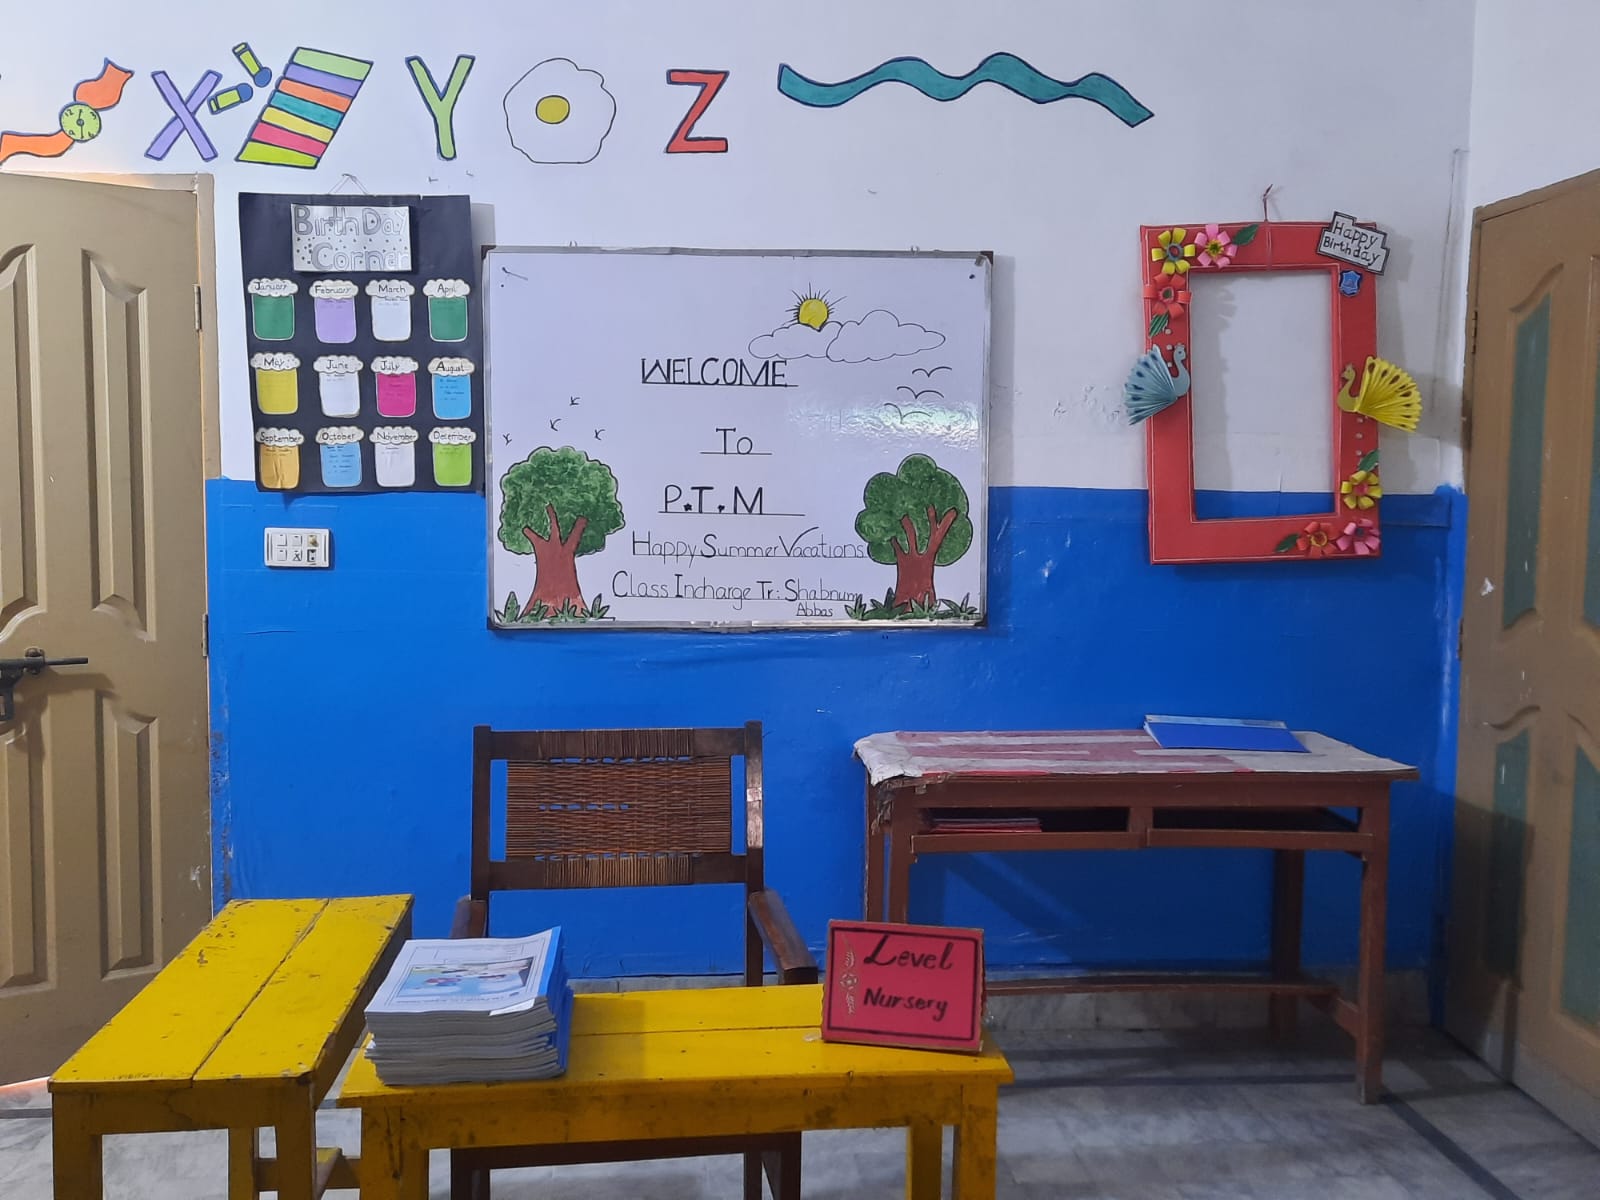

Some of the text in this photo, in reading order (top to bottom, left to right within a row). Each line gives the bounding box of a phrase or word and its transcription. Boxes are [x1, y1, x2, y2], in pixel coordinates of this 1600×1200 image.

[144, 69, 222, 161] X
[405, 54, 476, 160] Y
[665, 69, 730, 154] Z
[1332, 221, 1378, 249] Happy
[311, 242, 409, 271] Corner
[1323, 235, 1381, 267] Birthday
[253, 281, 288, 292] January
[314, 284, 353, 295] February
[378, 284, 406, 294] March
[437, 283, 458, 297] April
[263, 357, 285, 368] May
[325, 359, 349, 370] June
[380, 360, 400, 372] July
[436, 361, 465, 374] August
[641, 357, 788, 387] WELCOME
[260, 432, 301, 444] September
[321, 431, 356, 443] October
[376, 431, 416, 441] November
[433, 430, 472, 441] December
[715, 427, 753, 455] To
[632, 526, 866, 568] Happy Summer Vacations
[612, 570, 669, 598] Class
[674, 573, 752, 611] Incharge
[796, 600, 833, 617] Abbas
[863, 933, 954, 970] Level
[863, 986, 948, 1022] Nursery
